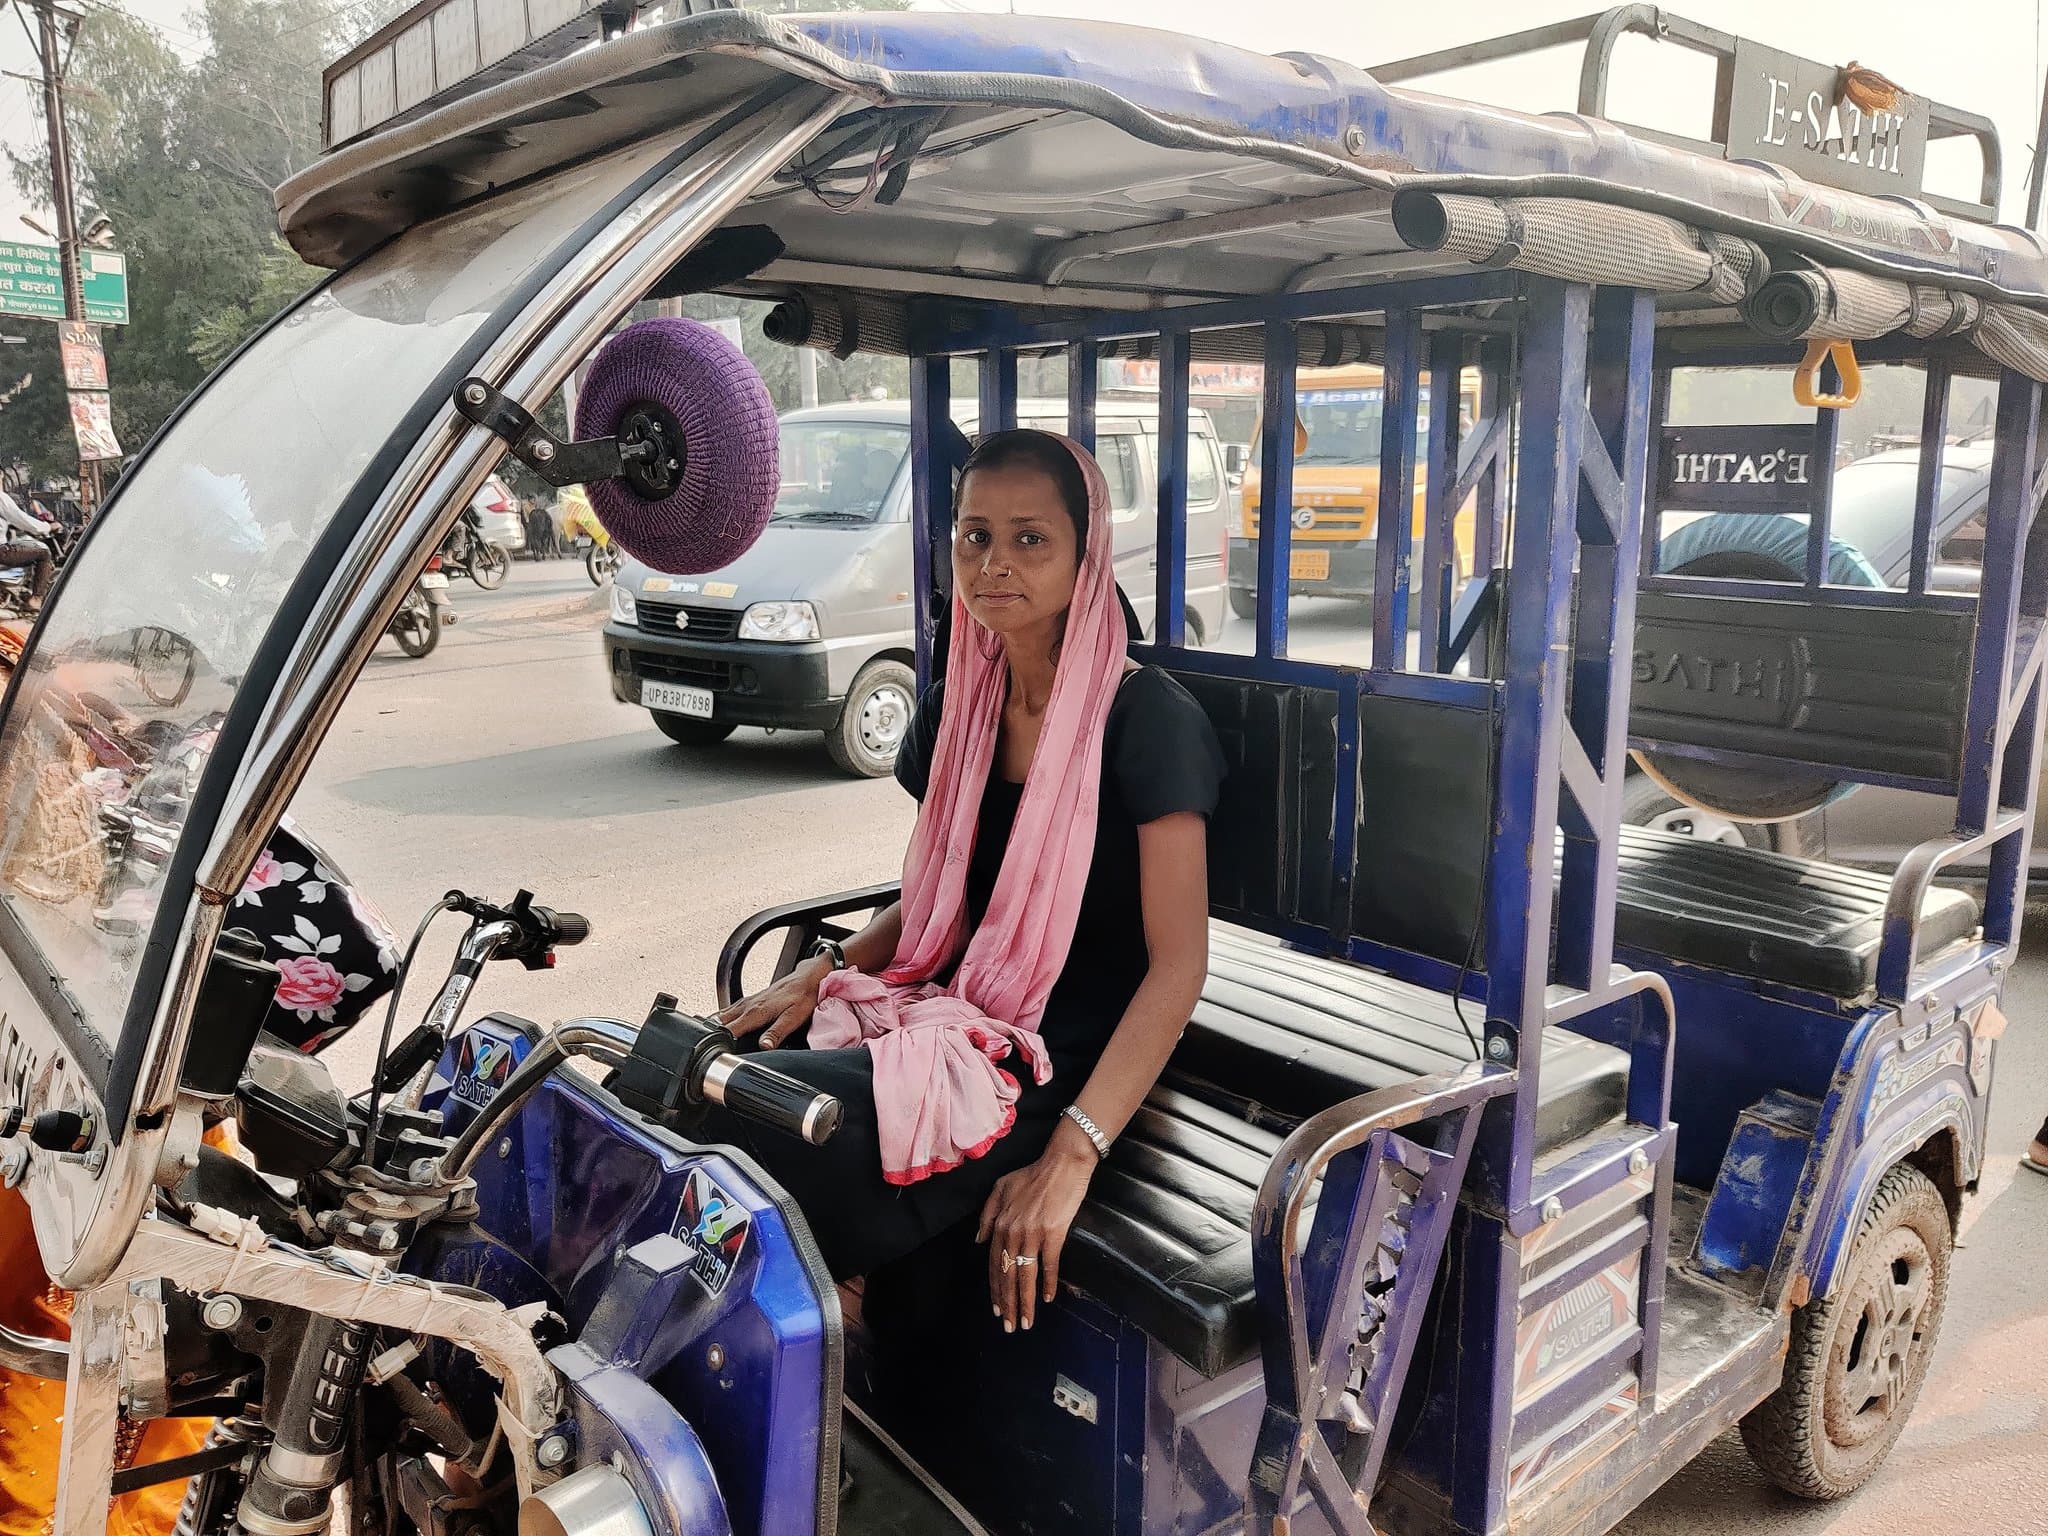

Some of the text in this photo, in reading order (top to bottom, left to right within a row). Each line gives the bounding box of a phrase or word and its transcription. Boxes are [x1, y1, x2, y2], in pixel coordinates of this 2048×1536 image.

[1762, 77, 1904, 174] E-SATHI
[457, 1075, 501, 1106] SATH
[1555, 1303, 1612, 1359] SATHI
